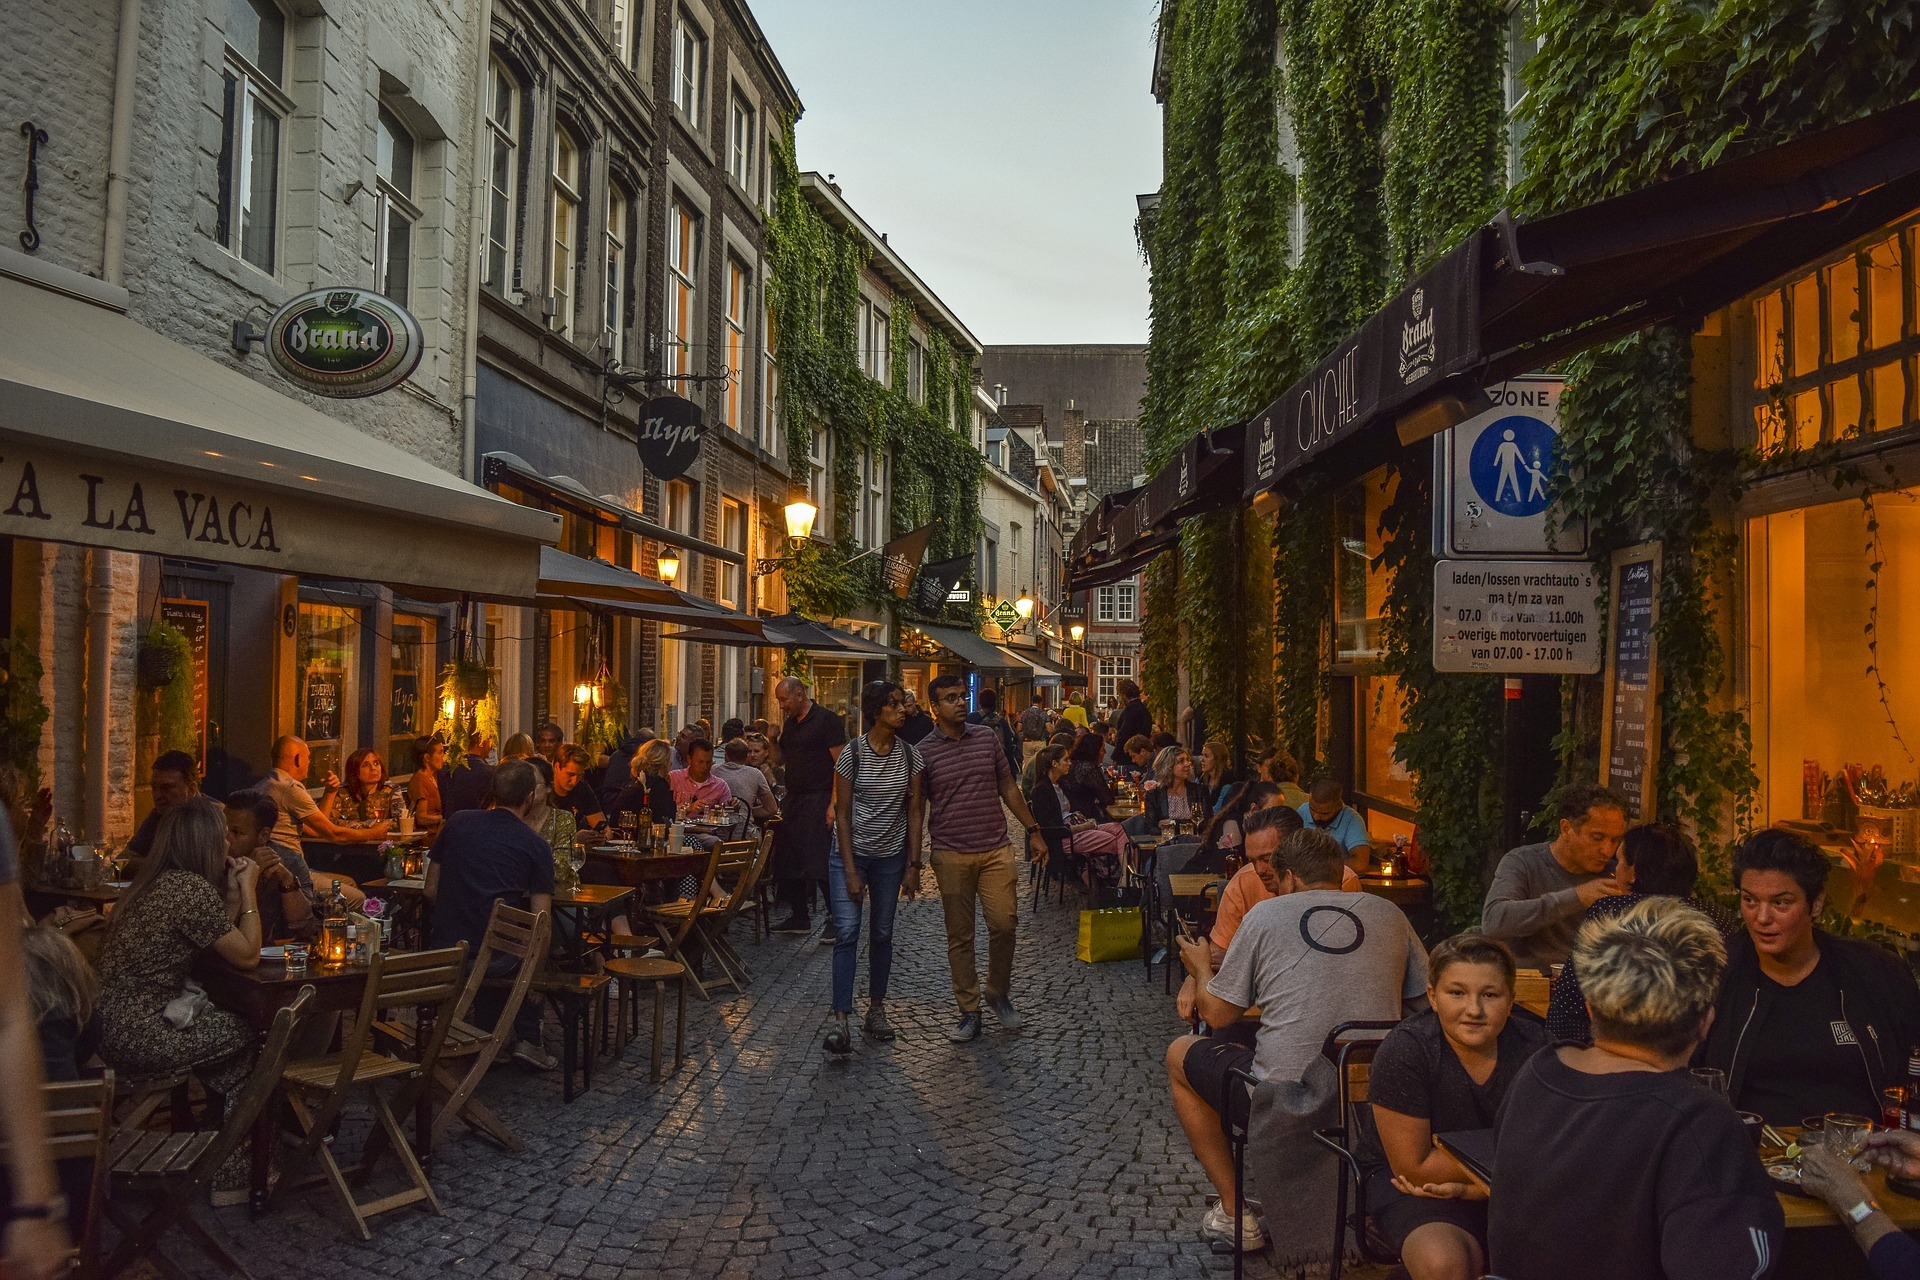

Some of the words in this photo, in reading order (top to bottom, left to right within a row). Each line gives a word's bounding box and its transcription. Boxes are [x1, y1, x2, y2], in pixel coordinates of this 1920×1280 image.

[290, 316, 381, 354] Brand
[1402, 308, 1433, 354] Brand
[1489, 390, 1550, 407] ZONE
[641, 417, 700, 456] Ilya
[0, 457, 51, 520] A
[78, 473, 156, 535] LA
[173, 489, 281, 553] VACA
[1452, 572, 1520, 587] laden/lossen
[1488, 593, 1504, 604] ma
[1507, 591, 1528, 606] t/m
[1531, 595, 1542, 605] za
[1545, 595, 1564, 605] van
[1458, 609, 1485, 622] 07.0
[1458, 628, 1497, 643] overige
[1500, 629, 1586, 645] motorvoertuigen
[1471, 648, 1489, 659] van
[1493, 647, 1523, 660] 07.00
[1533, 648, 1563, 660] 17.00
[1566, 649, 1572, 660] h
